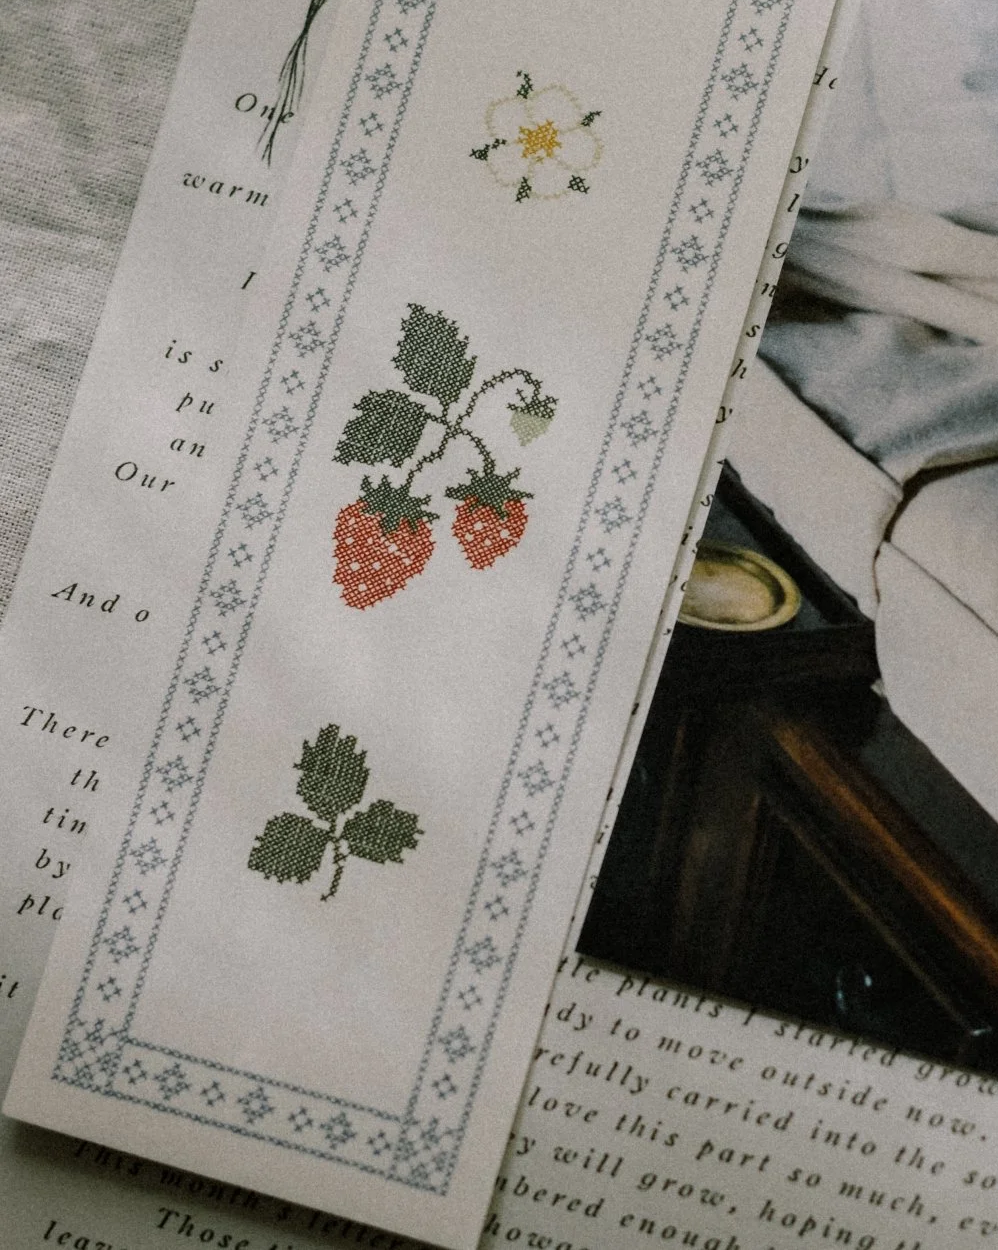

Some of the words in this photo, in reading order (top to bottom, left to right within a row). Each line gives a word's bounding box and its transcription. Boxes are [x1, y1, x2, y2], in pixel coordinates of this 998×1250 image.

[234, 92, 295, 125] One
[182, 172, 270, 208] warm
[240, 271, 258, 291] I
[164, 339, 193, 365] is
[175, 391, 215, 416] pu
[169, 436, 207, 458] an
[114, 460, 176, 493] Our
[50, 581, 121, 615] And
[18, 704, 112, 750] There
[69, 768, 101, 792] th
[42, 806, 88, 836] tin
[35, 848, 71, 879] by
[616, 974, 724, 1020] plants
[774, 1020, 897, 1068] started
[610, 1017, 642, 1042] to
[657, 1035, 746, 1072] move
[760, 1065, 889, 1113] outside
[905, 1103, 987, 1143] now.
[666, 1086, 795, 1132] carried
[810, 1118, 877, 1157] into
[893, 1146, 946, 1177] the
[527, 1086, 600, 1124] love
[614, 1113, 680, 1149] this
[695, 1138, 772, 1174] part
[787, 1167, 823, 1189] so
[838, 1180, 940, 1225] much,
[160, 1168, 293, 1222] months
[553, 1144, 626, 1179] will
[636, 1170, 739, 1217] grow,
[757, 1199, 876, 1250] hoping
[43, 1220, 127, 1250] leav
[158, 1206, 251, 1250] Those
